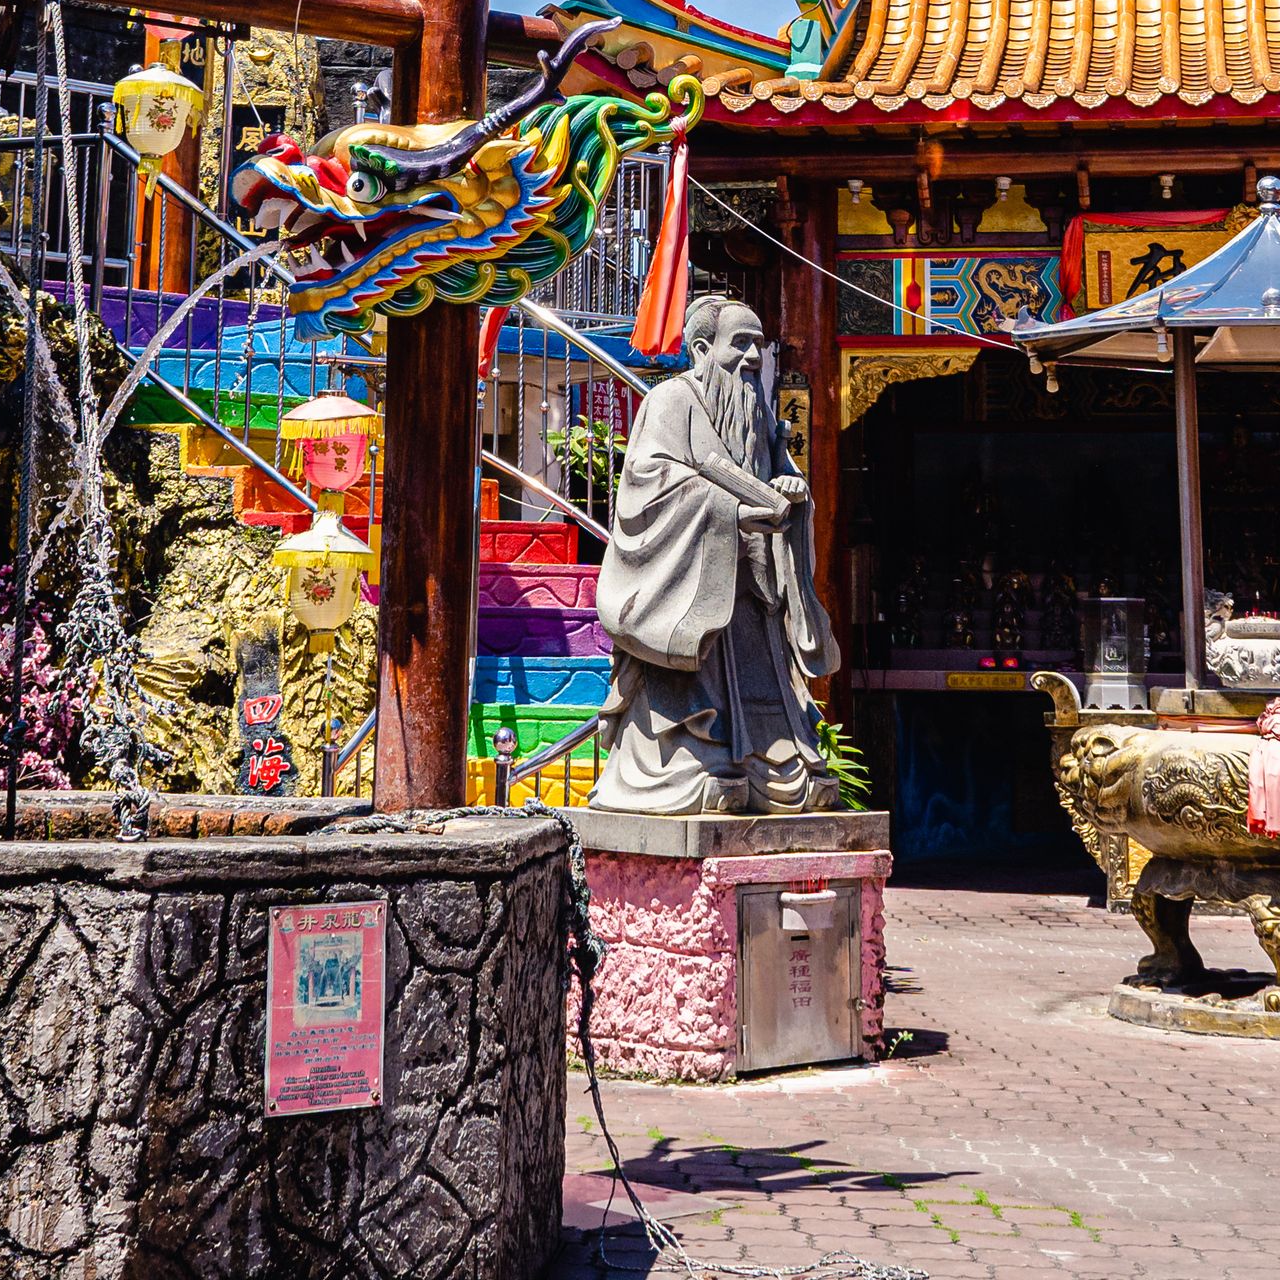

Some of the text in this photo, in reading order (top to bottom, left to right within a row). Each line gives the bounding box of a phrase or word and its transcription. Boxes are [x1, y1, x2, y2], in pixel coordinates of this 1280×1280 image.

[243, 694, 291, 791] 四海
[296, 911, 363, 933] 龍泉井
[789, 949, 812, 1009] 廣種福田
